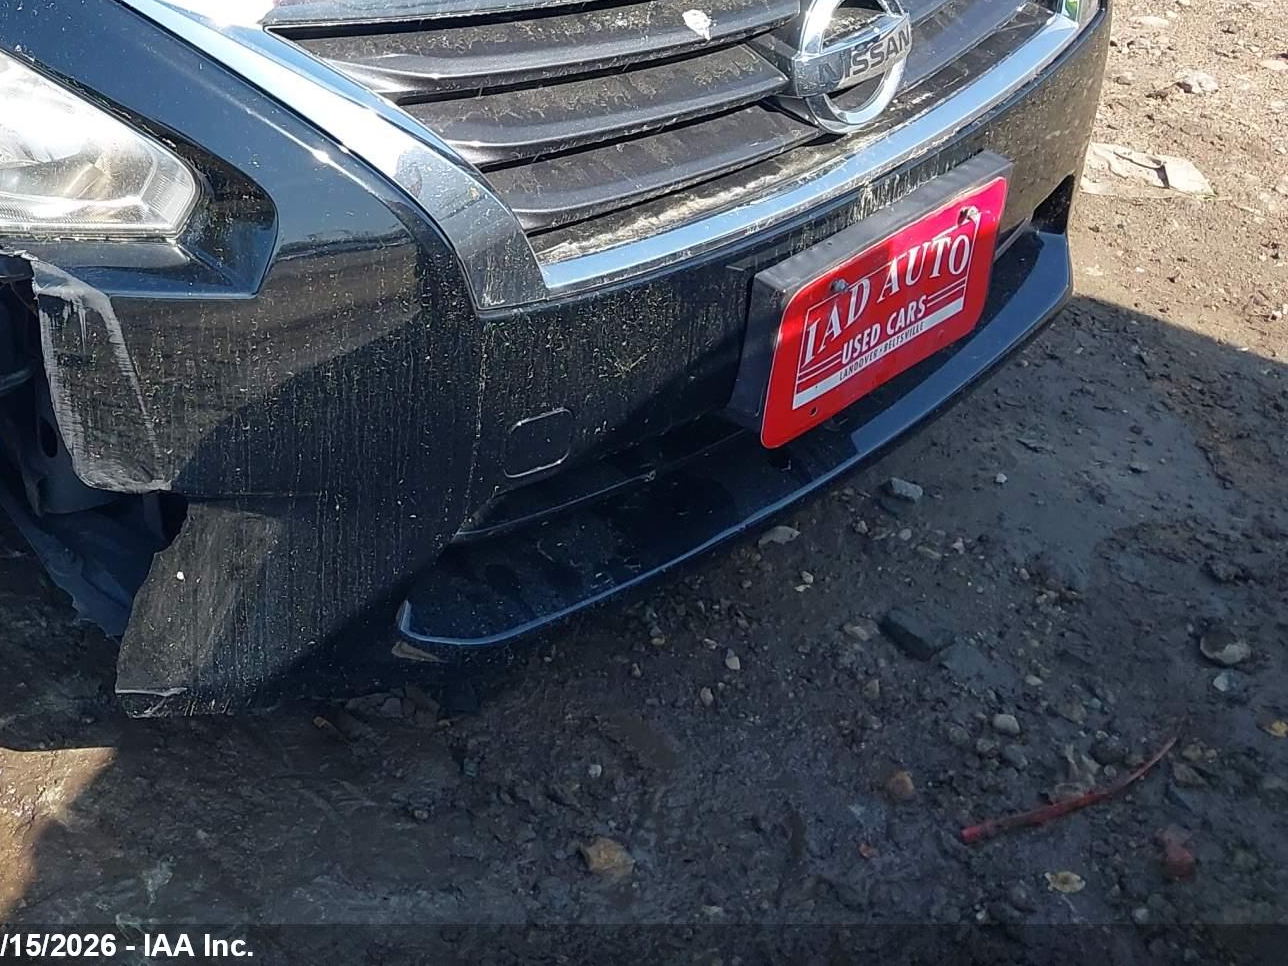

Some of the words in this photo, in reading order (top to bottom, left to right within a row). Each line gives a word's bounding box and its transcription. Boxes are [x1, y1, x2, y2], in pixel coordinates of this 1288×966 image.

[818, 24, 910, 82] NISSAN
[876, 233, 971, 304] AUTO
[839, 348, 879, 382] LANDOVER
[882, 321, 926, 353] BELTSVILLE
[842, 322, 882, 365] USED
[886, 294, 928, 335] CARS
